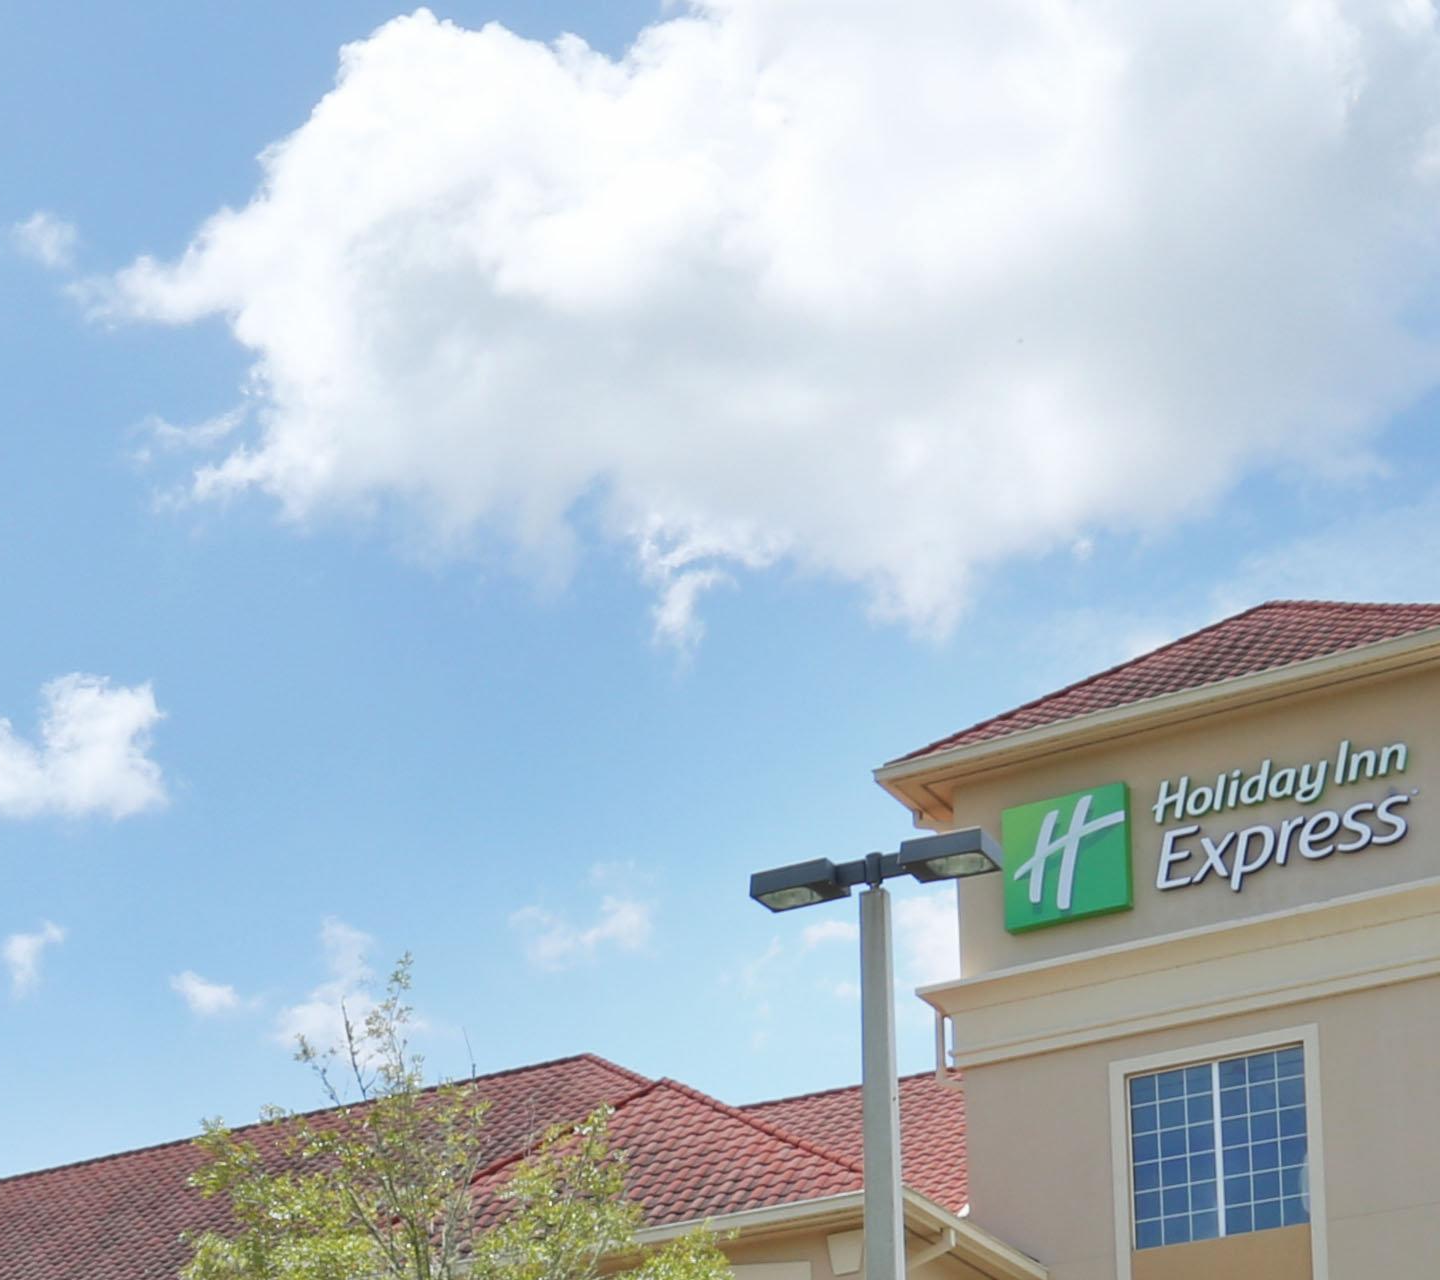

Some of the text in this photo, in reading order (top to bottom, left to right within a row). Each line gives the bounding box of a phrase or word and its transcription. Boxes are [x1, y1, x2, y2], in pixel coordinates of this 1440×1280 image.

[1152, 740, 1408, 824] Holiday Inn
[1156, 794, 1410, 893] Express
